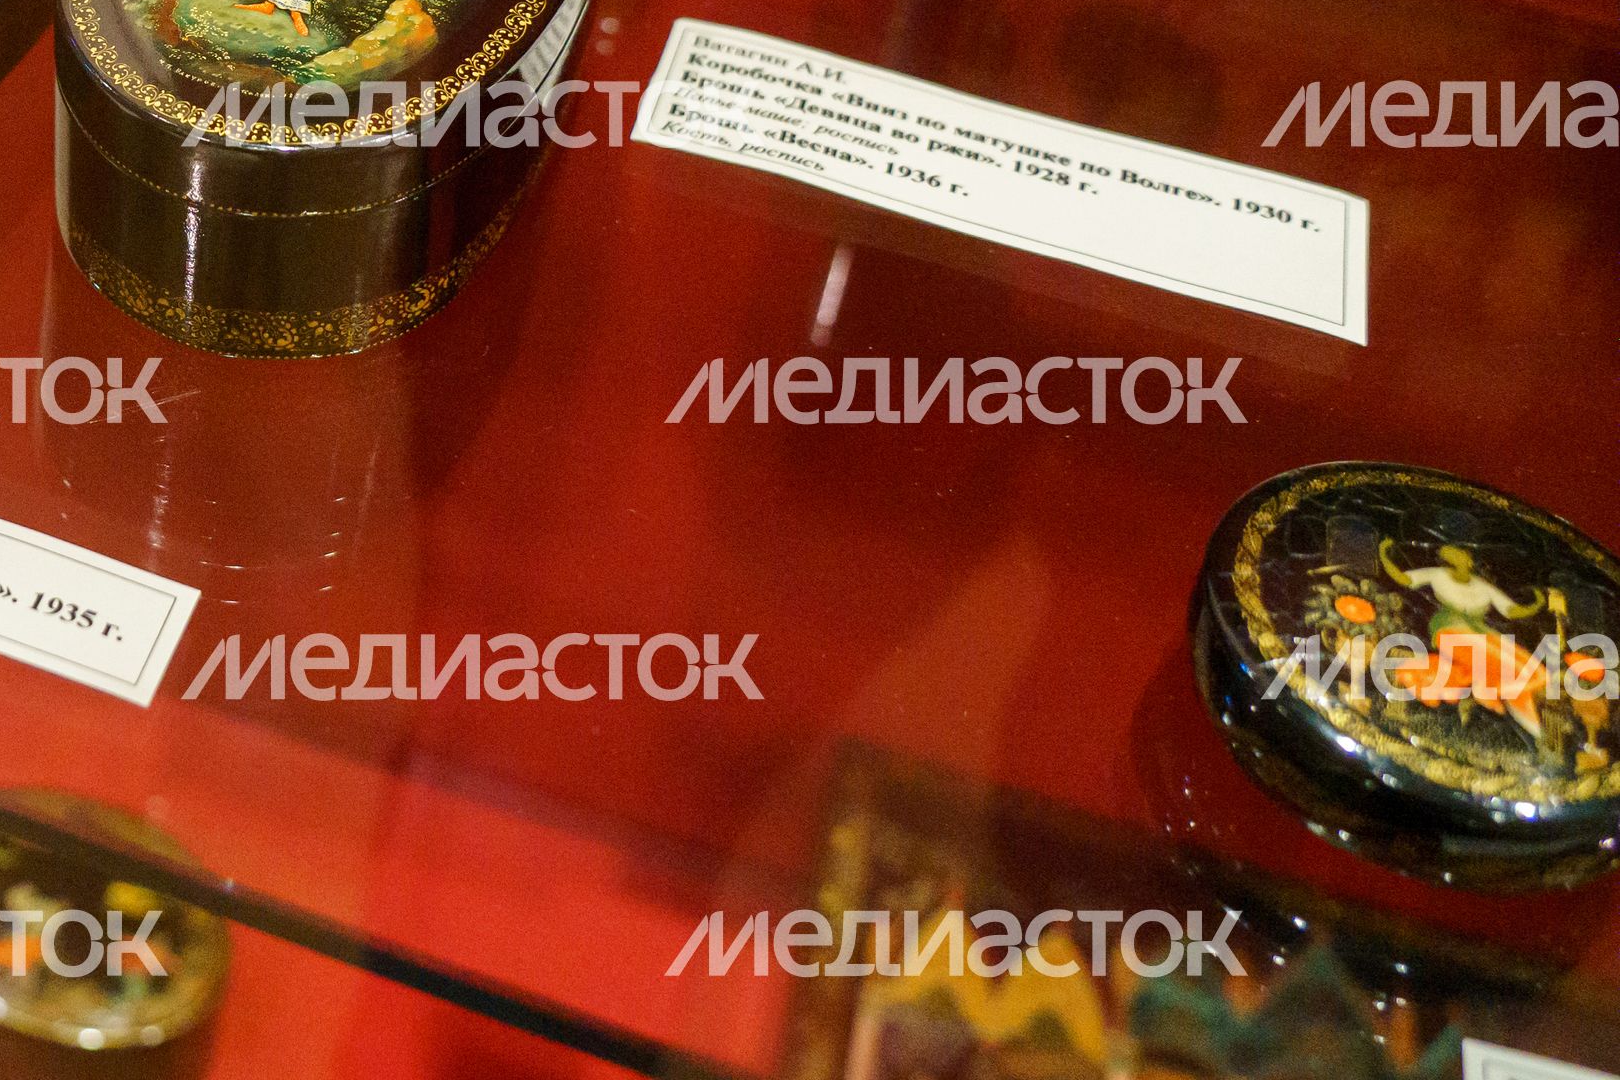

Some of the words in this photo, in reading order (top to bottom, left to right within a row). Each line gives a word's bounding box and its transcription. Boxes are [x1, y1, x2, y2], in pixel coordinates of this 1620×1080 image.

[694, 36, 789, 67] Ватагин
[795, 60, 847, 84] А.И.
[687, 53, 823, 95] Коробочка
[831, 90, 908, 120] «Вниз
[916, 115, 947, 132] по
[953, 126, 1071, 167] матушке
[1079, 161, 1111, 177] по
[1119, 168, 1221, 207] Волге».
[1231, 197, 1292, 224] 1930
[1299, 218, 1321, 233] г.
[738, 142, 826, 172] роспись
[764, 127, 874, 170] «Весна».
[884, 161, 941, 188] 1936
[949, 181, 969, 197] г.
[774, 94, 882, 133] «Девица
[891, 128, 920, 145] во
[926, 138, 1002, 168] ржи».
[1013, 159, 1071, 186] 1928
[1078, 179, 1099, 196] г.
[812, 124, 900, 155] роспись
[28, 590, 96, 629] 1935
[99, 617, 124, 642] г.
